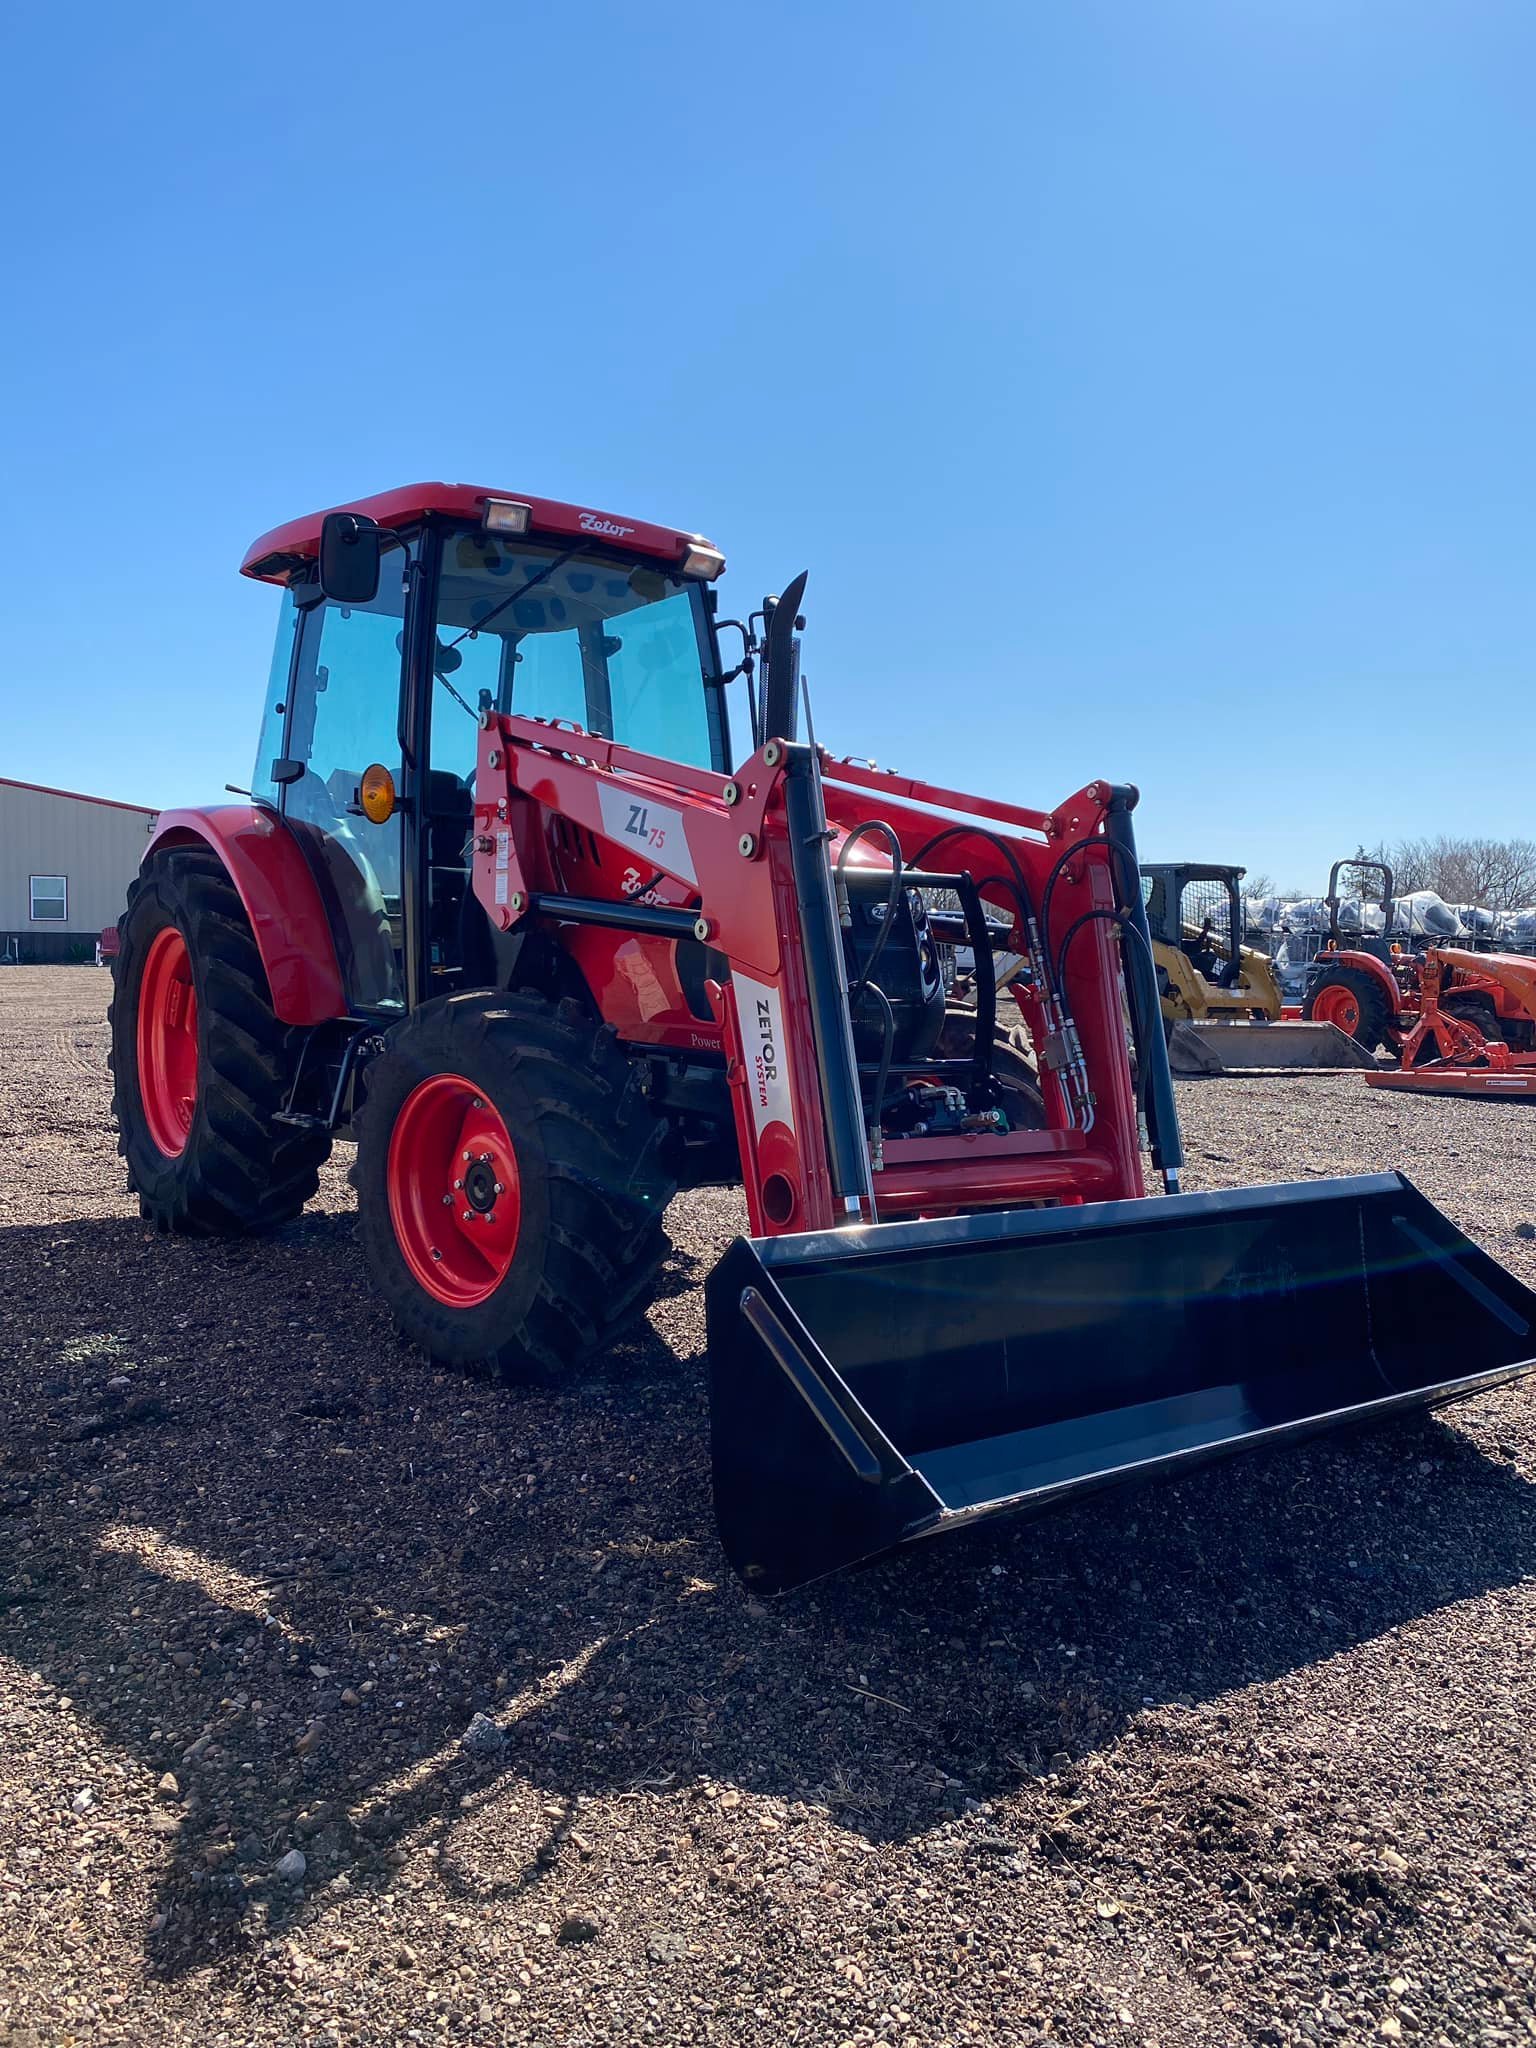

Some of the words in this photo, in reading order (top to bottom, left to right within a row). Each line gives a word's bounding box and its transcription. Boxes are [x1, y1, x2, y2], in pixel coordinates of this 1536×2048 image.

[579, 513, 634, 536] Zetor
[625, 805, 648, 837] ZL
[648, 828, 665, 848] 75
[691, 1033, 720, 1049] Power
[757, 1000, 777, 1081] ZETOR
[755, 1055, 768, 1107] SYSTEM
